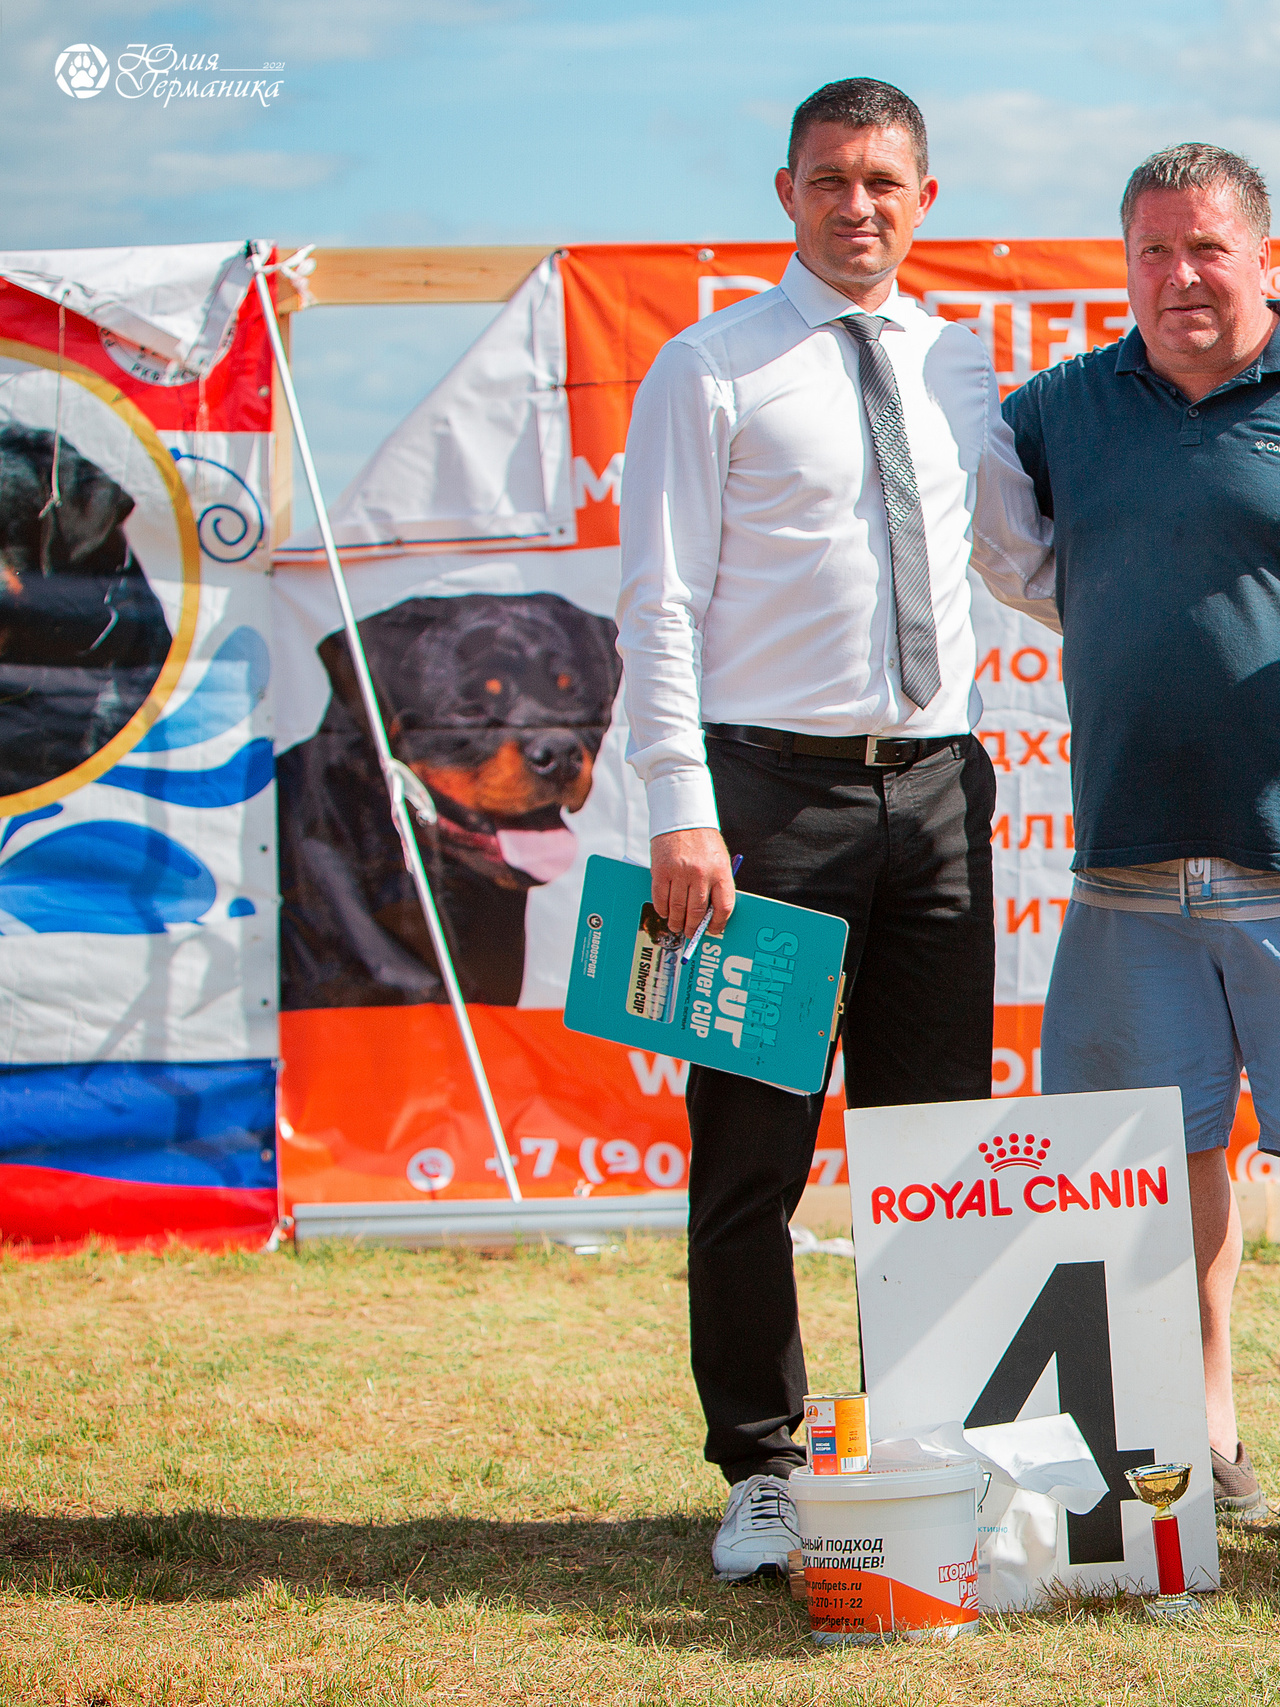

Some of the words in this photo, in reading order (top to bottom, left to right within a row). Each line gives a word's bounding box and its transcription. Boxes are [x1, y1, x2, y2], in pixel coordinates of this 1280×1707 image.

[587, 931, 601, 979] TABOOSPORT
[696, 942, 722, 998] Silver
[636, 961, 651, 994] Silver
[633, 992, 646, 1014] CUP
[690, 999, 713, 1039] CUP
[578, 1137, 686, 1188] (90
[871, 1178, 1013, 1225] ROYAL
[1023, 1165, 1169, 1214] CANIN
[963, 1260, 1155, 1566] 4
[812, 1555, 885, 1571] ПИТОМЦЕВ!
[826, 1538, 884, 1555] ПОДХОД
